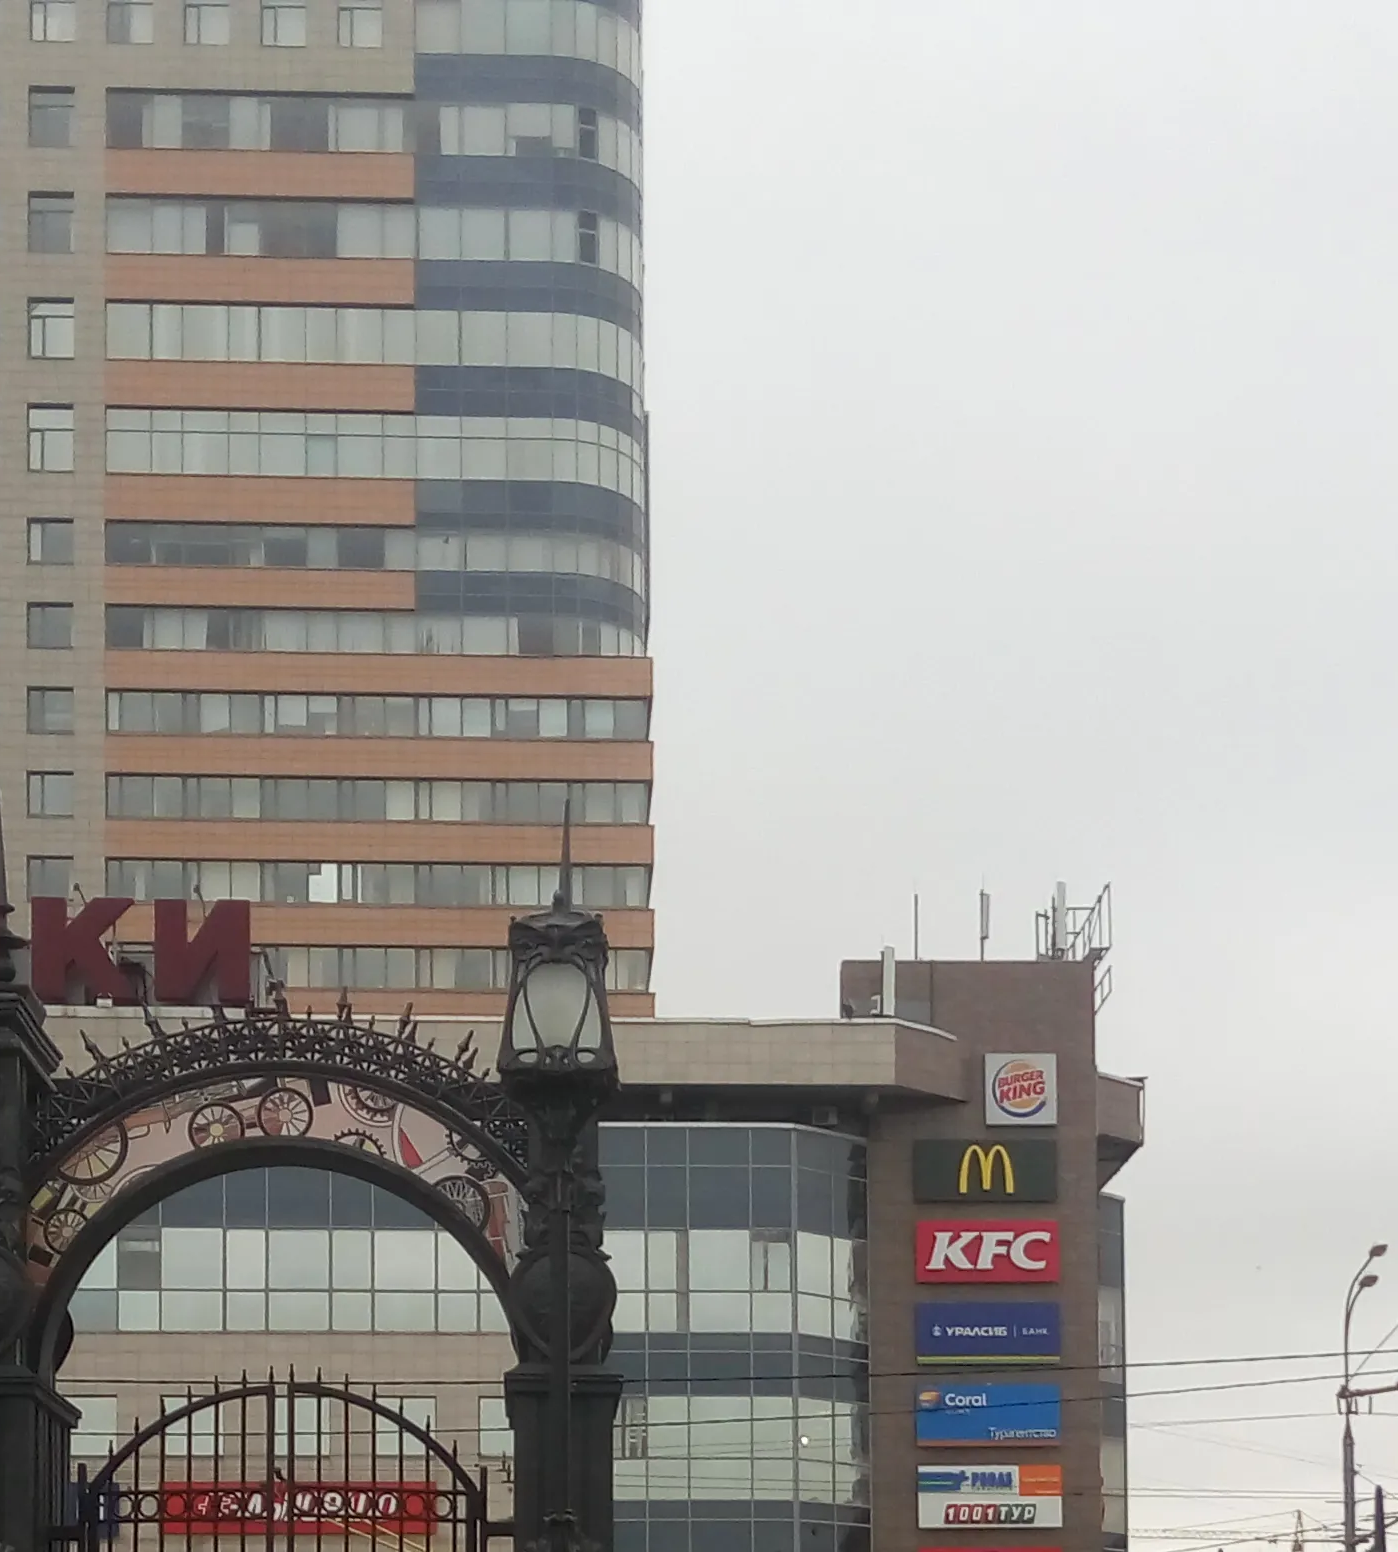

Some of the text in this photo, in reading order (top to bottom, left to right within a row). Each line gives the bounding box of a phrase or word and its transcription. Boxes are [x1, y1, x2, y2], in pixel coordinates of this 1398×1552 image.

[997, 1069, 1045, 1090] BURGER
[998, 1081, 1046, 1105] KING
[924, 1230, 1052, 1271] KFC
[945, 1325, 1008, 1338] УРАЛСИБ
[944, 1393, 988, 1407] Coral
